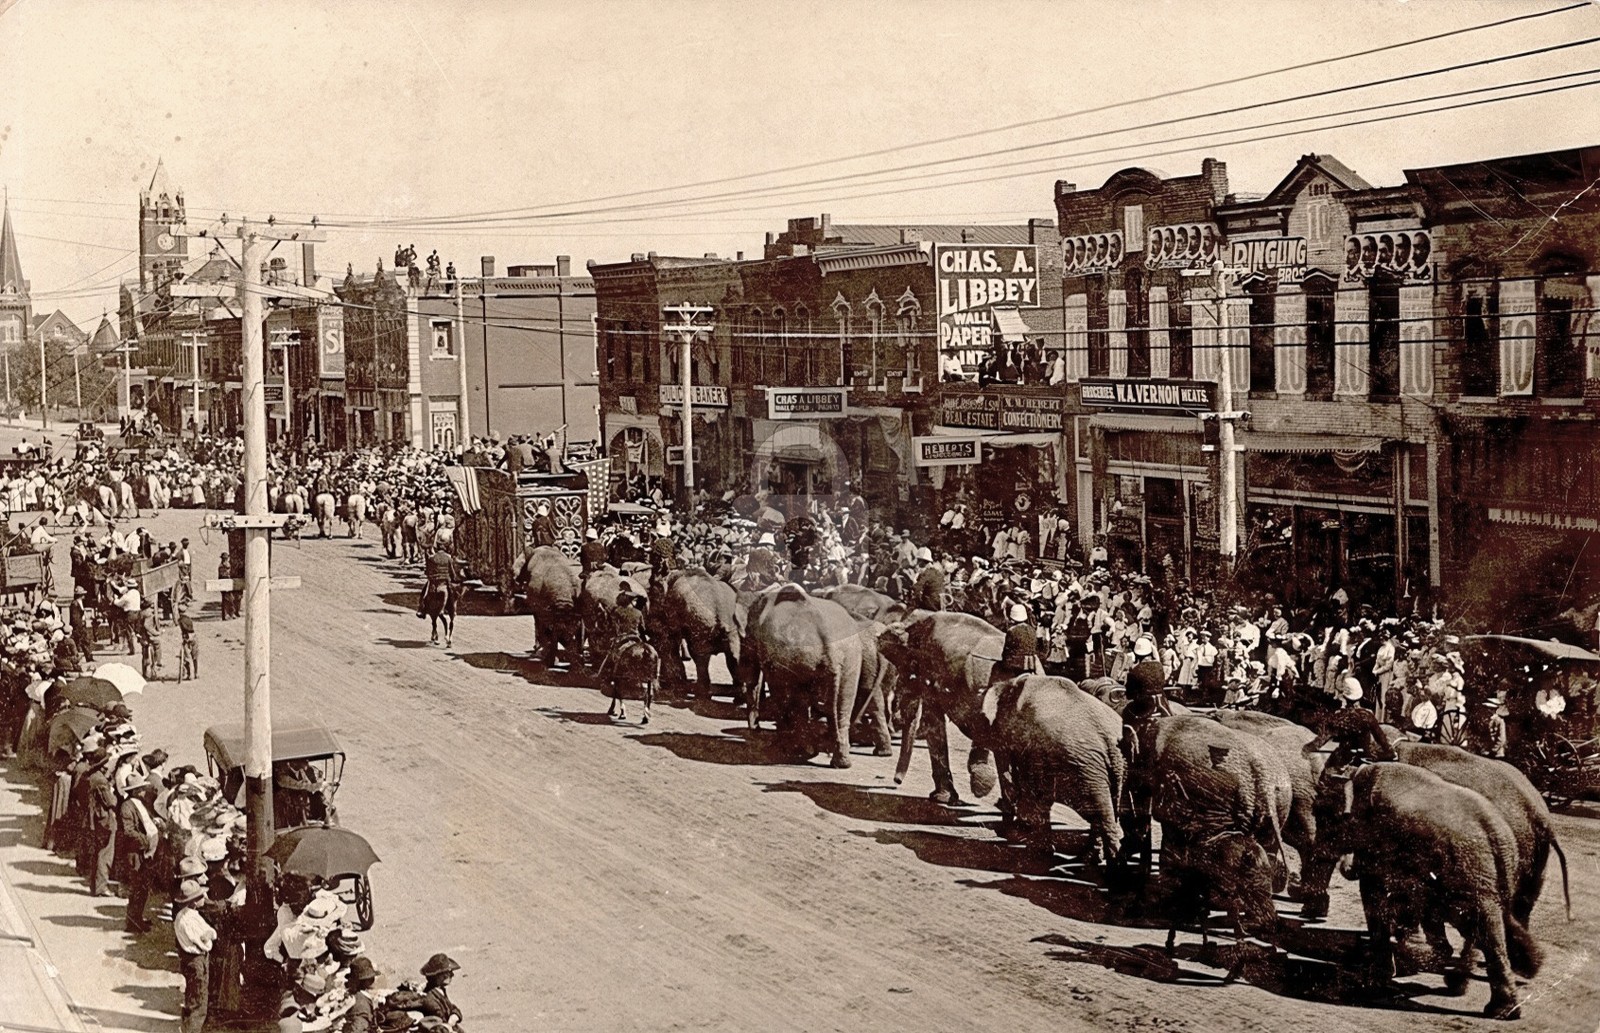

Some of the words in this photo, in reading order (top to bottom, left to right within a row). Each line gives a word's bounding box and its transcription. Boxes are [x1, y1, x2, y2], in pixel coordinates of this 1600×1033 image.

[940, 250, 1003, 273] CHAS.
[1012, 250, 1035, 273] A.
[940, 278, 1036, 318] LIBBEY
[953, 312, 991, 325] WALL
[940, 322, 992, 349] PAPER
[1278, 327, 1304, 391] 10
[1338, 325, 1366, 393] 10
[1402, 325, 1432, 394] 10
[1501, 319, 1534, 392] 10
[696, 386, 729, 406] BAKERY
[806, 395, 840, 404] LIBBEY
[1135, 384, 1180, 405] VERNON
[1181, 389, 1209, 403] MEATS.
[1003, 411, 1063, 428] CONFECTIONERY.
